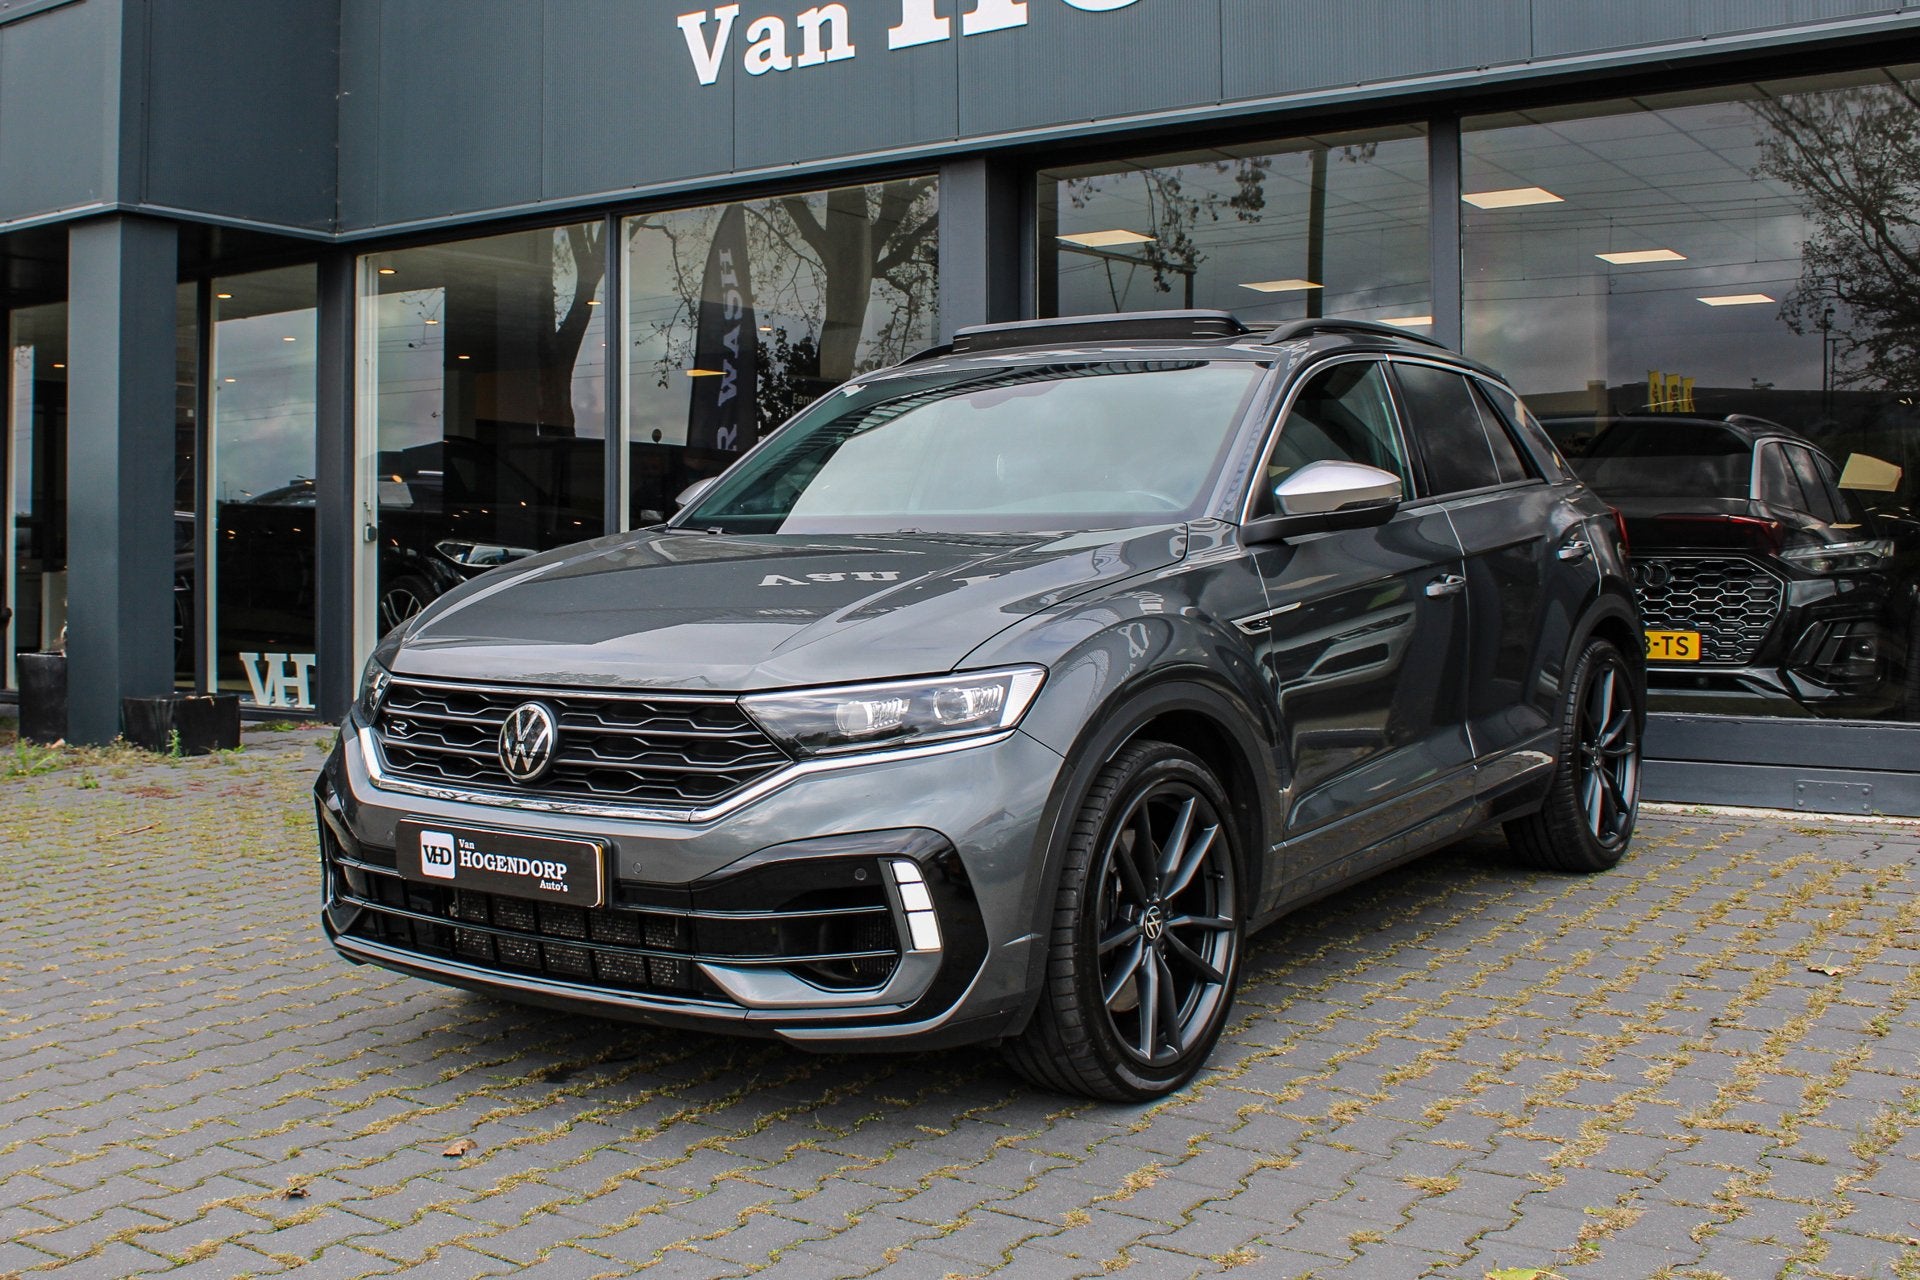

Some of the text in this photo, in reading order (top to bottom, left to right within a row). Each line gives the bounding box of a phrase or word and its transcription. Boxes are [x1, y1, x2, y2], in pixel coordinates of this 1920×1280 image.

[677, 3, 856, 86] Van
[717, 248, 743, 407] WASH
[422, 844, 452, 866] VHD
[458, 838, 475, 850] Van
[459, 850, 567, 880] HOGENDORP
[540, 880, 569, 893] Auto's
